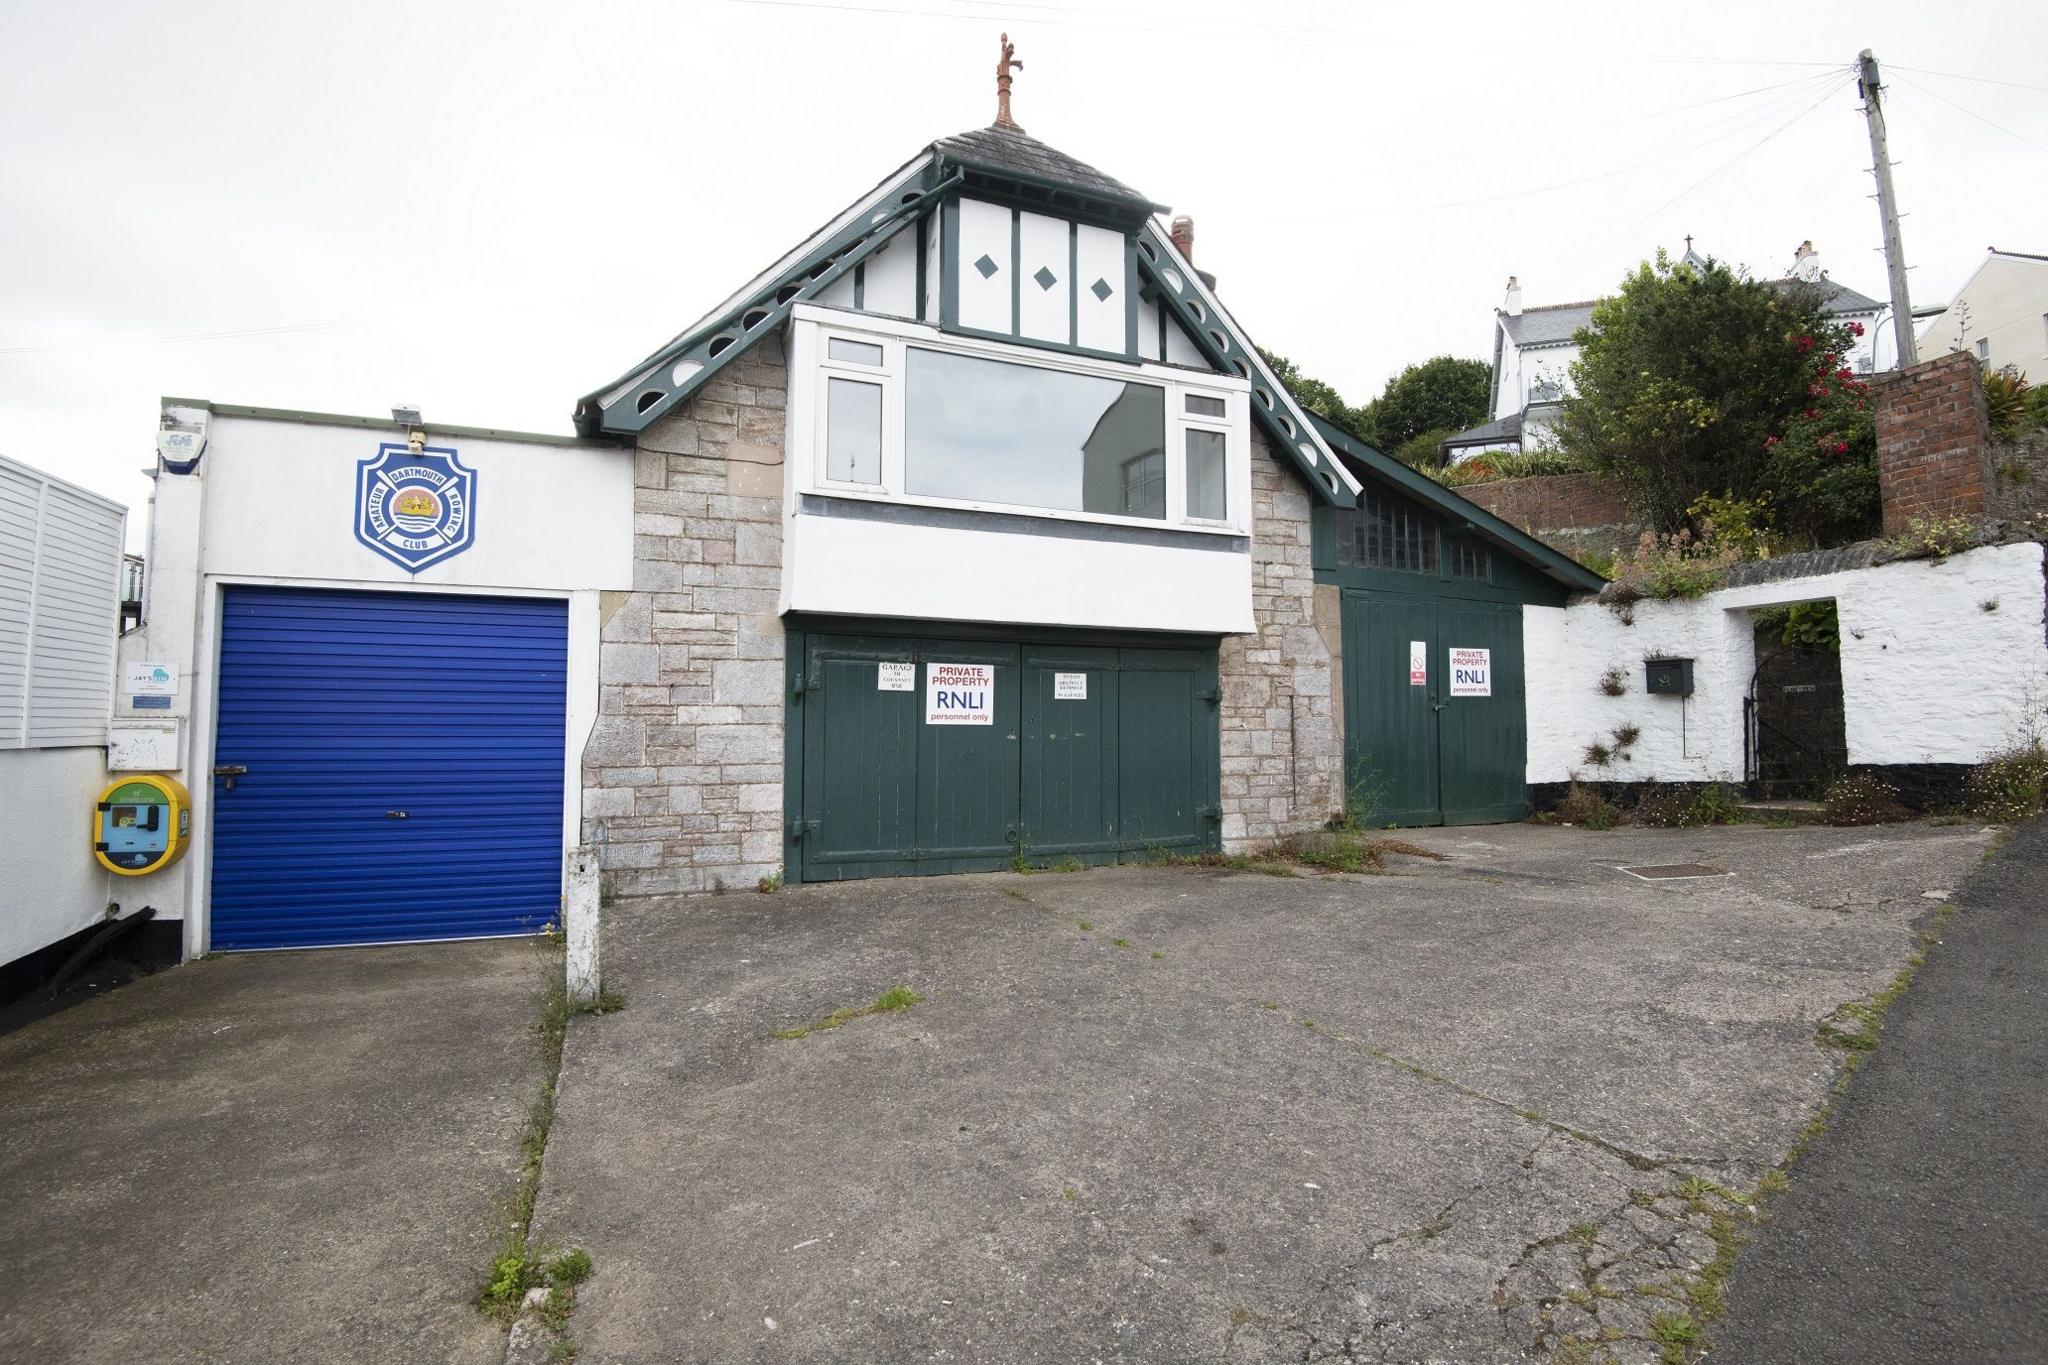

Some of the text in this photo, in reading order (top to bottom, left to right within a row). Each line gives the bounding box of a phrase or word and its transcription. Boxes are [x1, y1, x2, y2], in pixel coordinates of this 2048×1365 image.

[391, 468, 445, 486] DARTMOUTH
[370, 487, 386, 529] AMATEUR
[448, 492, 461, 533] ROWING
[403, 539, 428, 549] CLUB
[1452, 658, 1487, 666] PROPERTY
[882, 664, 913, 674] GARAGE
[939, 667, 984, 677] PRIVATE
[932, 676, 989, 686] PROPERTY
[1456, 669, 1485, 683] RNLI
[937, 691, 984, 709] RNLI
[931, 713, 989, 722] personnel only
